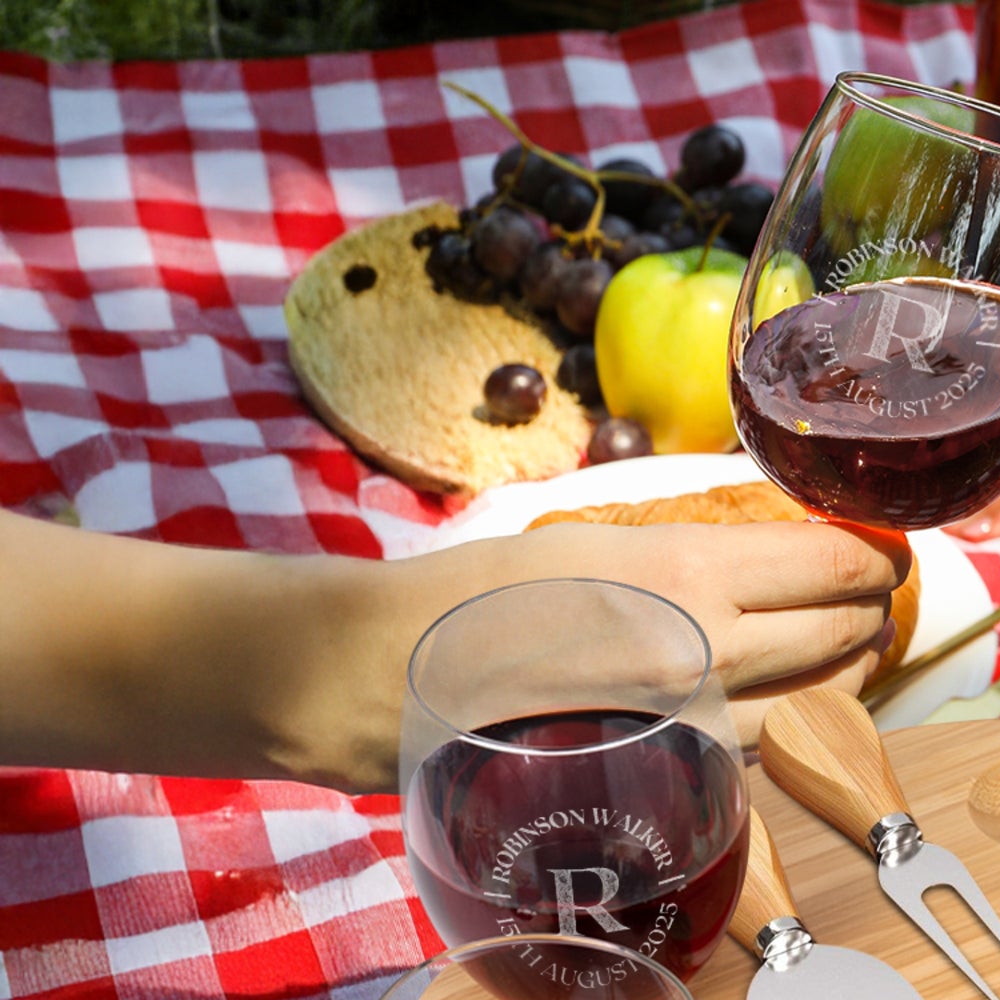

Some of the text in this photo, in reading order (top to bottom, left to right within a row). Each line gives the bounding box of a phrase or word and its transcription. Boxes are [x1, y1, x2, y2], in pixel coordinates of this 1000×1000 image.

[825, 236, 935, 292] ROBINSON
[814, 322, 986, 420] 15TH AUGUST 2025
[864, 289, 935, 374] R
[492, 807, 673, 884] ROBINSON WALKER
[546, 867, 631, 937] R
[496, 902, 679, 989] 15H AUGUST 2025
